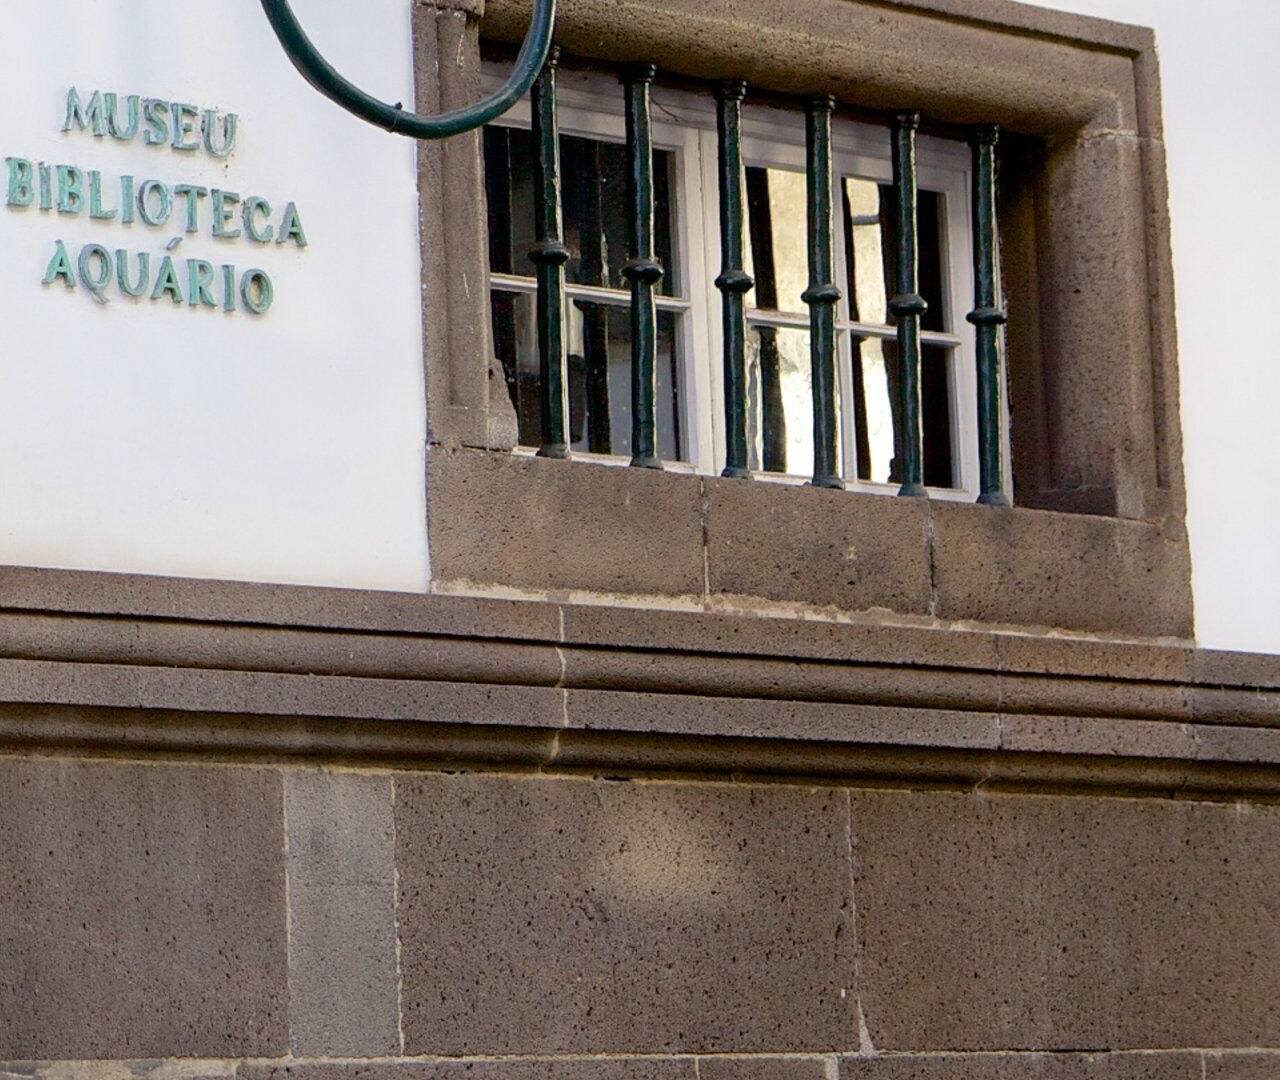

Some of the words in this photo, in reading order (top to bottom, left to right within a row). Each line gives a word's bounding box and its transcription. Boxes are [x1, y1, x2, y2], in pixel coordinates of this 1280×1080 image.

[60, 85, 239, 159] MUSEU
[4, 156, 308, 248] BIBLIOTECA
[41, 237, 274, 315] AQUÁRIO
